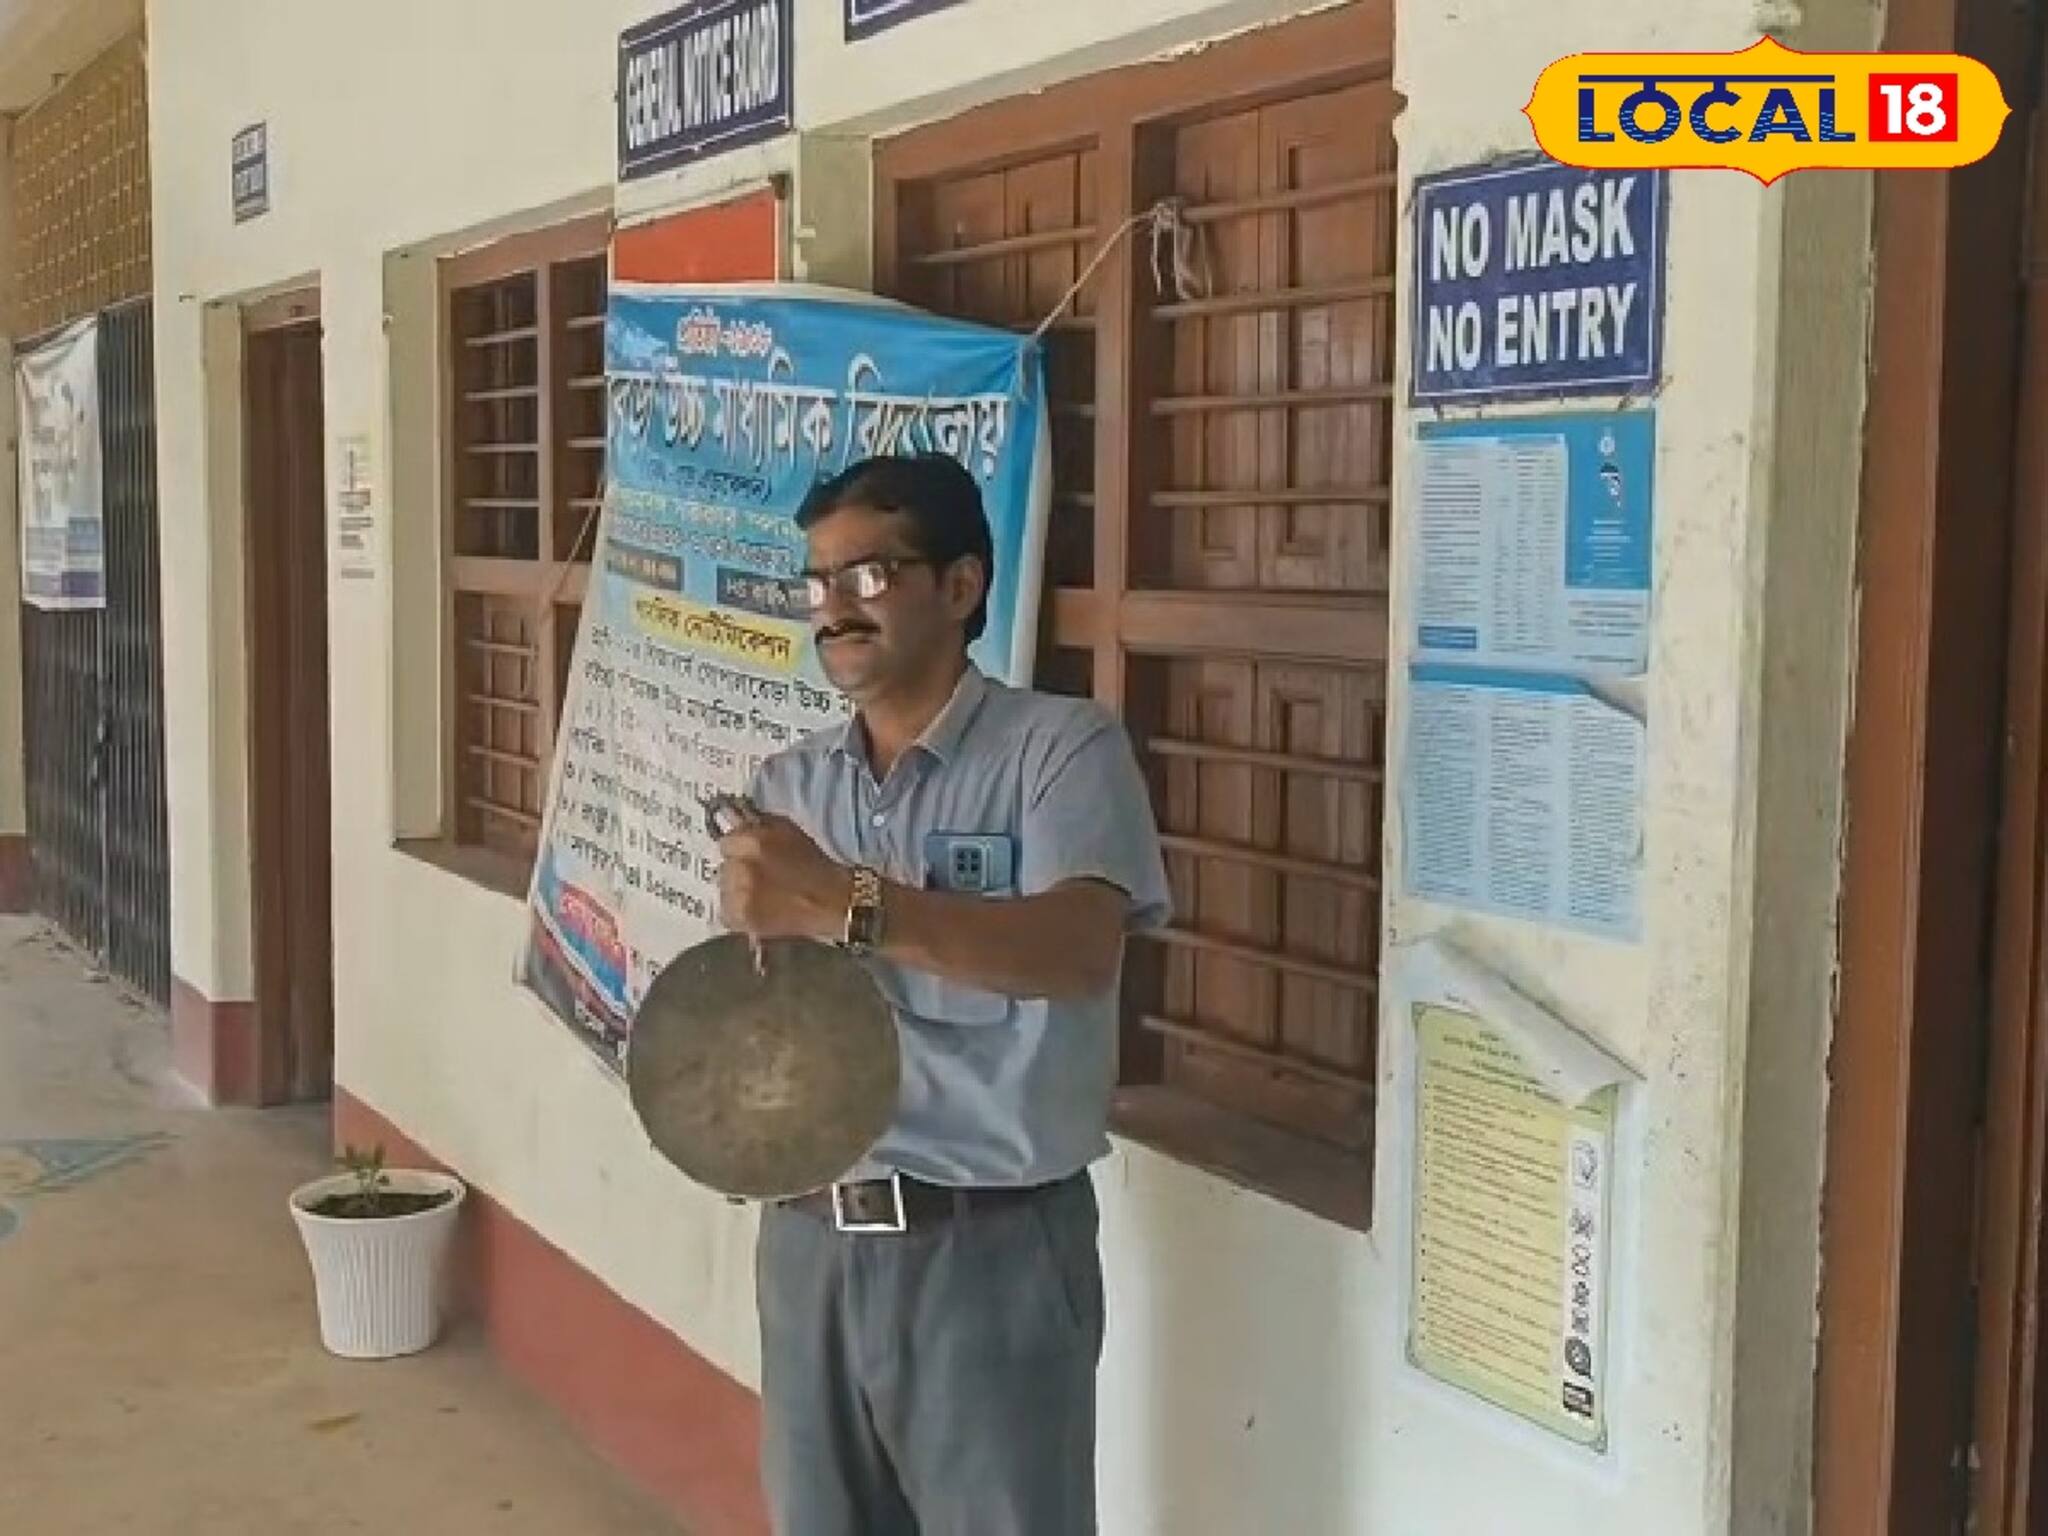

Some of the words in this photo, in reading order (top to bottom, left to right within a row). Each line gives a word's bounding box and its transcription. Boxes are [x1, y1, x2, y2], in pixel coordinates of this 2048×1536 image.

[683, 18, 731, 130] NOTICE
[733, 1, 779, 114] BOARD
[1430, 202, 1489, 281] NO
[1504, 177, 1637, 271] MASK
[1426, 301, 1481, 372] NO
[1495, 282, 1637, 367] ENTRY
